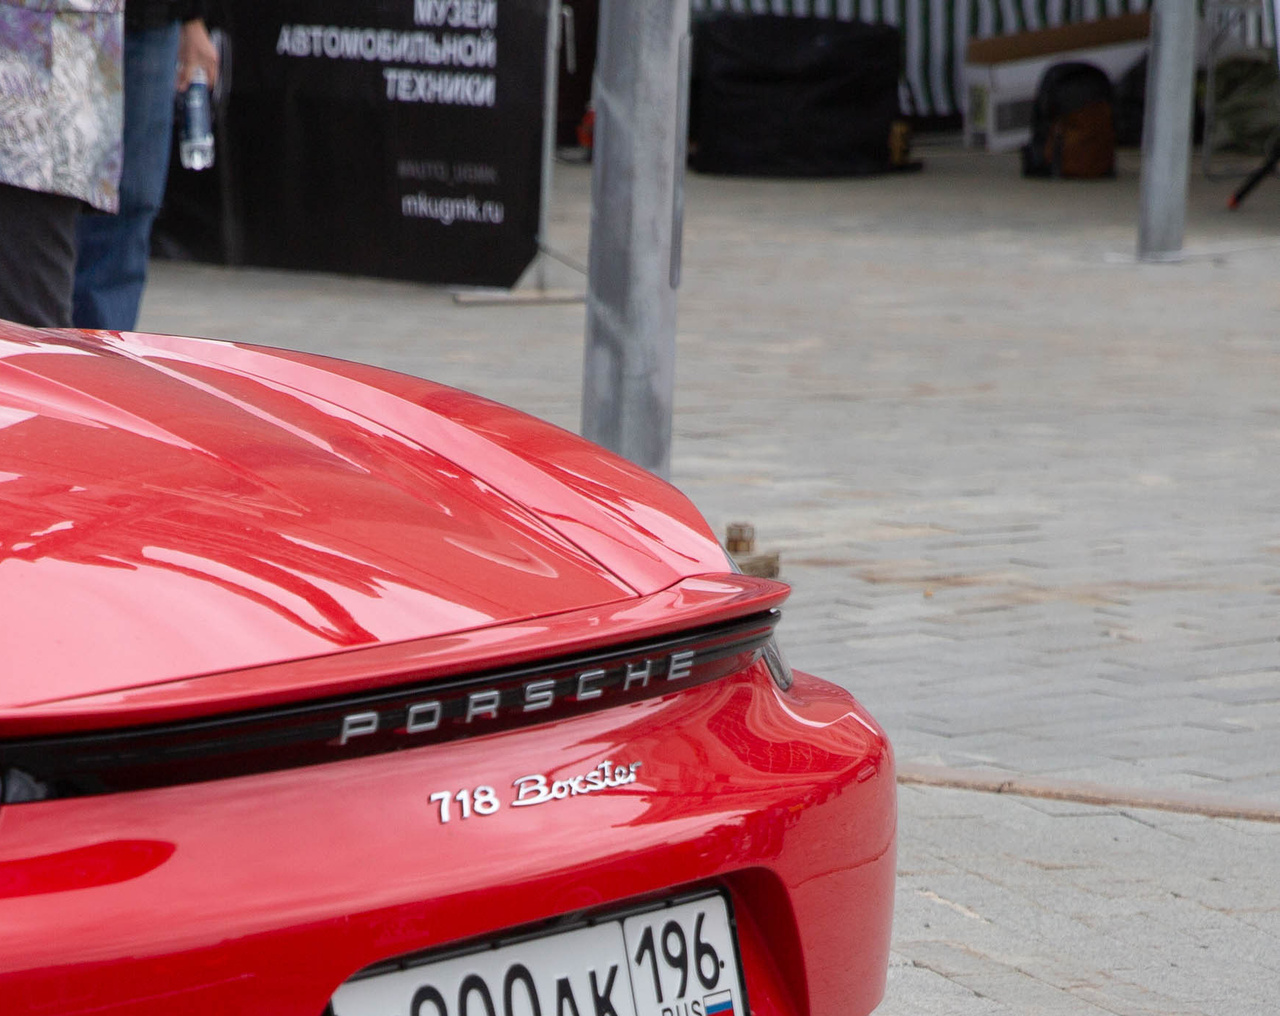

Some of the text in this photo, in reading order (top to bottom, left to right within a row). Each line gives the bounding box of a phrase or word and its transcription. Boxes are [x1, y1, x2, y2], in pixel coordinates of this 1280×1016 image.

[413, 0, 497, 28] МУЗЕЙ
[276, 24, 497, 67] АВТОМОБИЛЬНОЙ
[383, 67, 496, 107] ТЕХНИКИ
[401, 190, 505, 225] mkugmk.ru
[339, 650, 695, 745] PORSCHE
[429, 760, 642, 823] 718 Boxster
[635, 912, 721, 1003] 196
